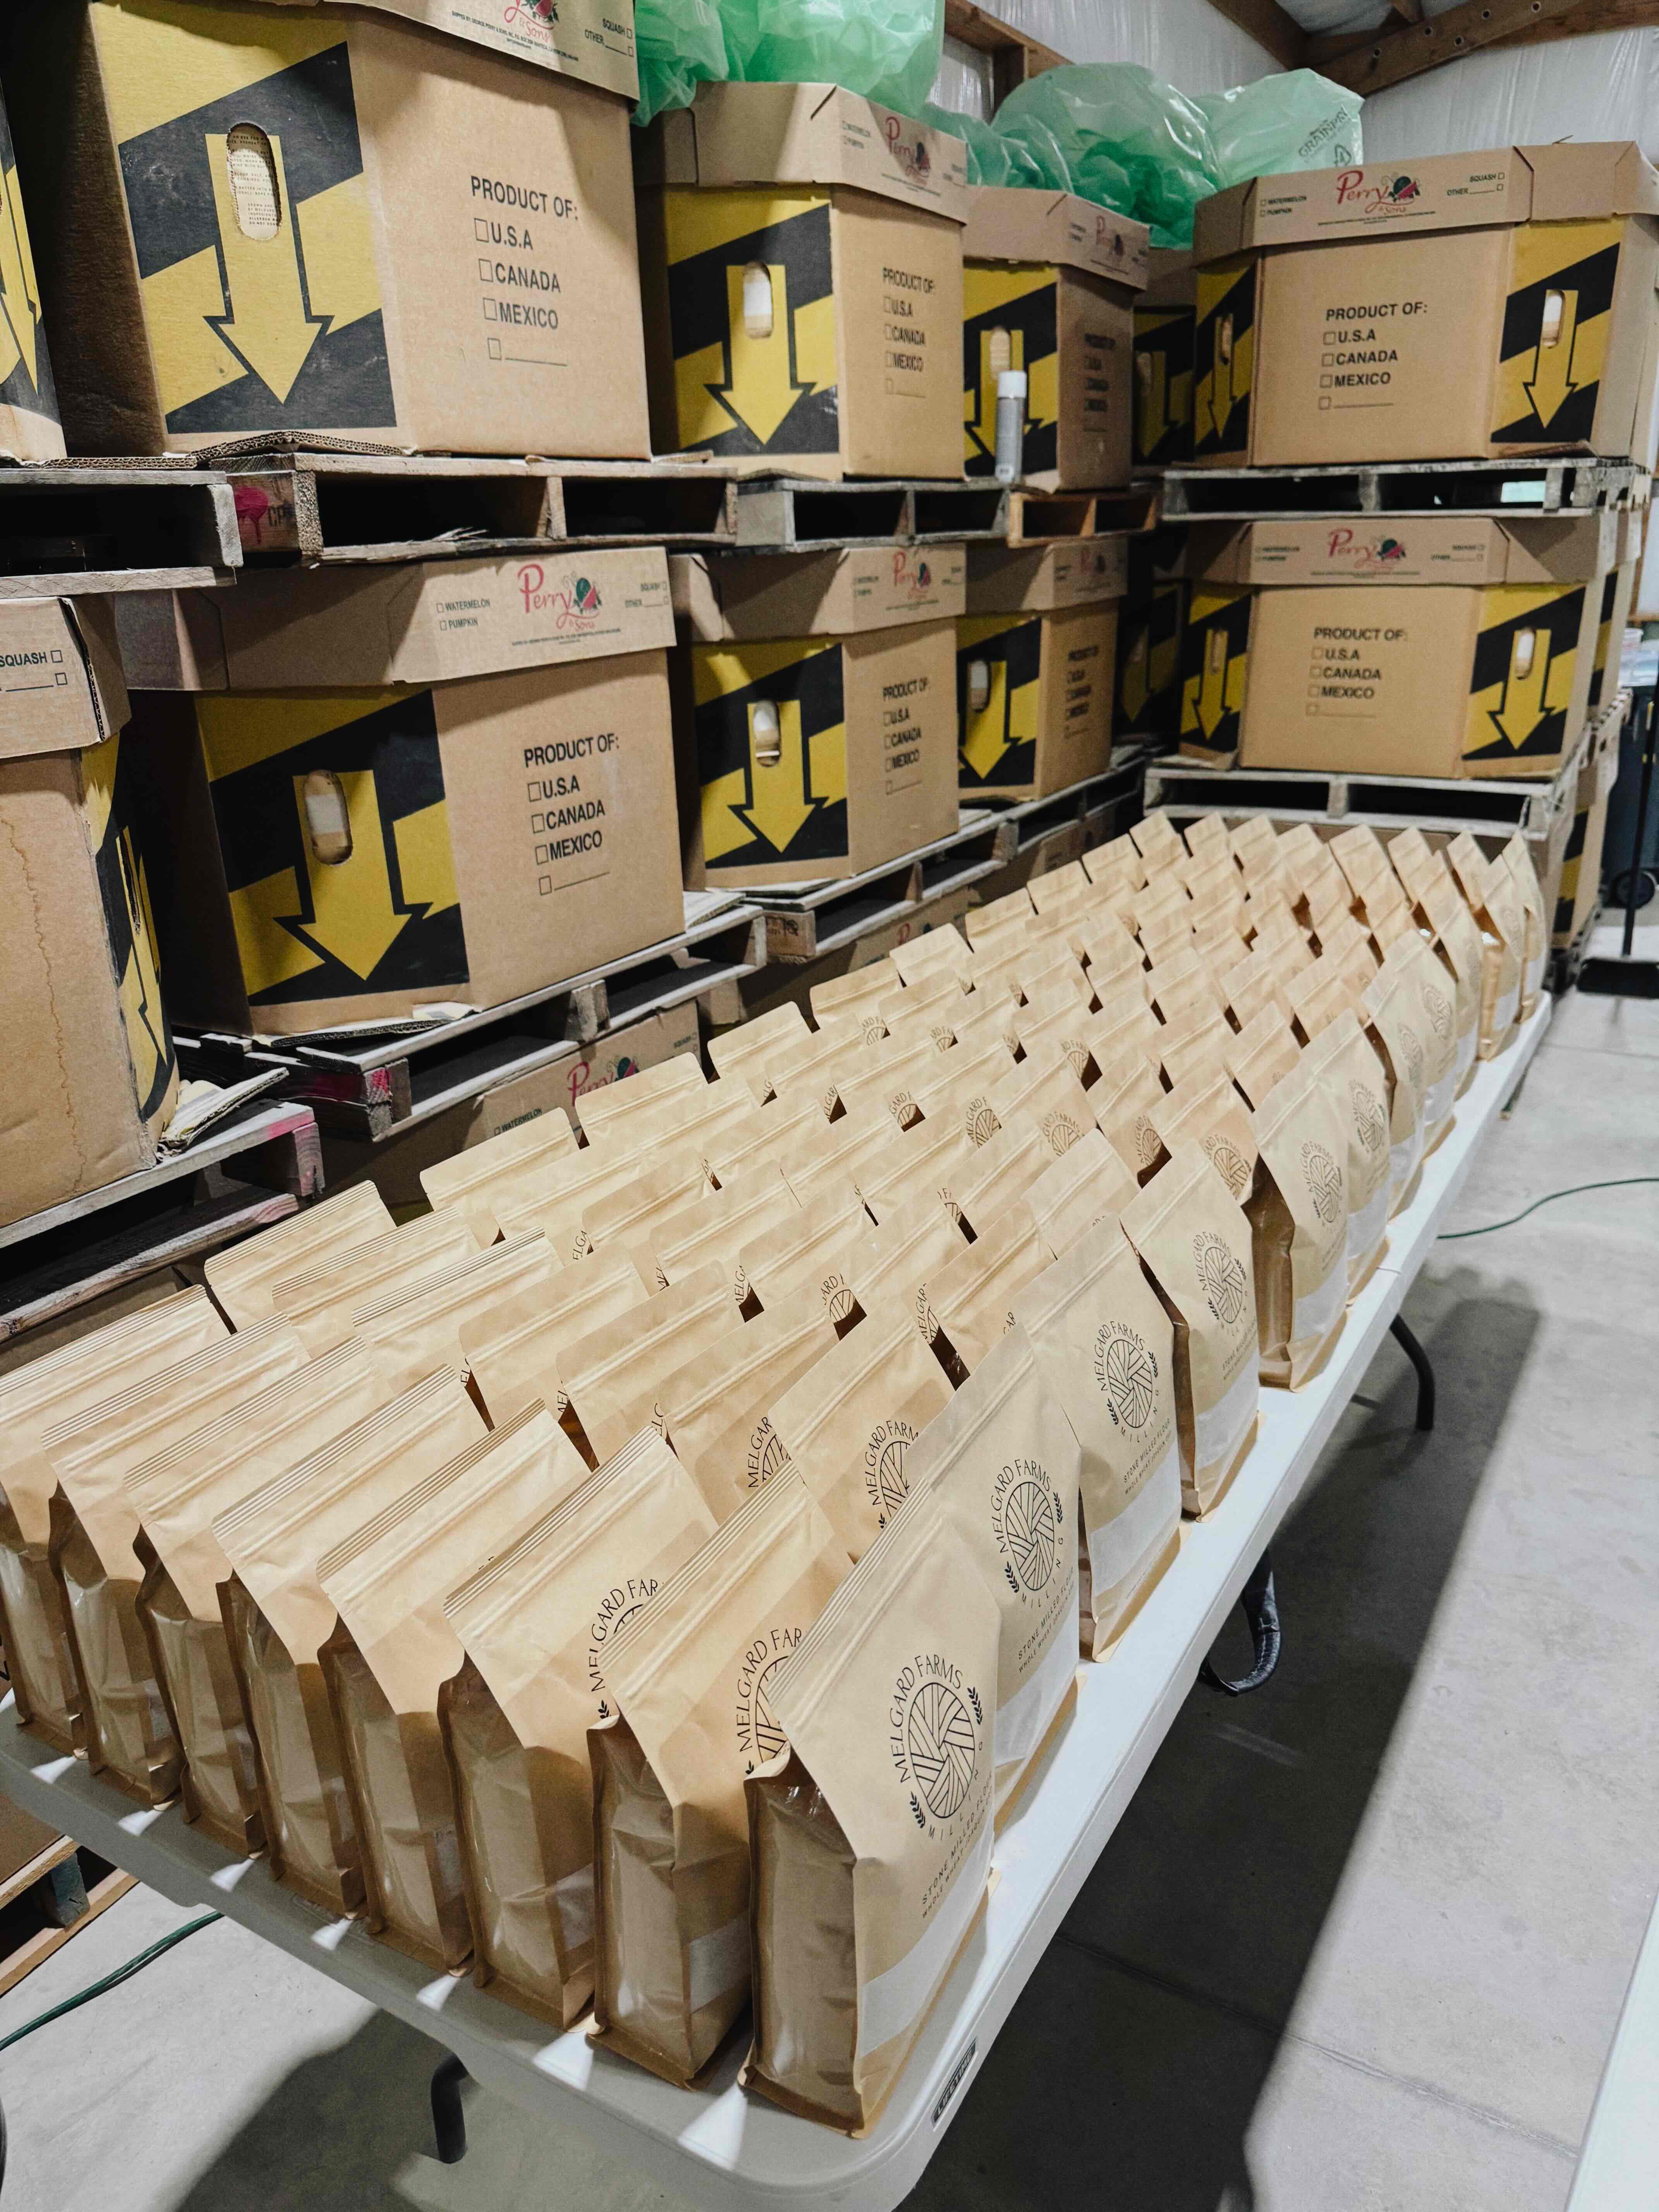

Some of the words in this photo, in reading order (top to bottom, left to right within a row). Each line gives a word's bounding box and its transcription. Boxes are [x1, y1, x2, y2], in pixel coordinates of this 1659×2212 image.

[1336, 170, 1390, 213] Perry
[1446, 188, 1468, 196] OTHER
[1469, 173, 1496, 182] SQUASH
[471, 175, 548, 213] PRODUCT
[554, 196, 578, 221] OF:
[491, 222, 533, 250] U.S.A
[495, 263, 561, 293] CANADA
[883, 267, 922, 290] PRODUCT
[499, 302, 558, 329] MEXICO
[1326, 304, 1398, 321] PRODUCT
[1402, 301, 1428, 315] OF:
[1338, 328, 1376, 343] U.S.A
[1336, 350, 1398, 366] CANADA
[1334, 372, 1391, 388] MEXICO
[445, 599, 490, 611] WATERMELON
[517, 563, 575, 629] Perry
[448, 617, 478, 630] PUMPKIN
[1314, 627, 1381, 641] PRODUCT
[0, 652, 48, 667] SQUASH
[1323, 666, 1381, 680] CANADA
[1321, 686, 1375, 699] MEXICO
[524, 737, 594, 768] PRODUCT
[597, 733, 619, 752] OF:
[543, 775, 580, 799] U.S.A
[546, 799, 606, 830] CANADA
[550, 830, 602, 861] MEXICO
[1193, 1235, 1209, 1291] MELGARD
[1094, 1324, 1112, 1391] MELGARD
[1110, 1321, 1146, 1351] FARMS
[865, 1425, 886, 1506] MELGARD
[1124, 1459, 1139, 1483] STONE
[1140, 1437, 1156, 1461] MILLED
[991, 1465, 1014, 1554] MELGARD
[1015, 1459, 1051, 1492] FARMS
[627, 1578, 658, 1599] FAR
[1018, 1627, 1039, 1660] STONE
[1041, 1595, 1060, 1629] MILLED
[1018, 1650, 1037, 1673] WHOLE
[736, 1640, 768, 1752] MELGARD
[770, 1627, 803, 1650] FAR
[890, 1666, 916, 1784] MELGARD
[914, 1654, 963, 1690] FARMS
[929, 1741, 983, 1841] MILLING
[922, 1860, 948, 1905] STONE
[951, 1812, 974, 1858] MILLED
[922, 1884, 943, 1919] WHOLE
[945, 1848, 963, 1884] WHEAT
[937, 2048, 974, 2116] LIFETIME
